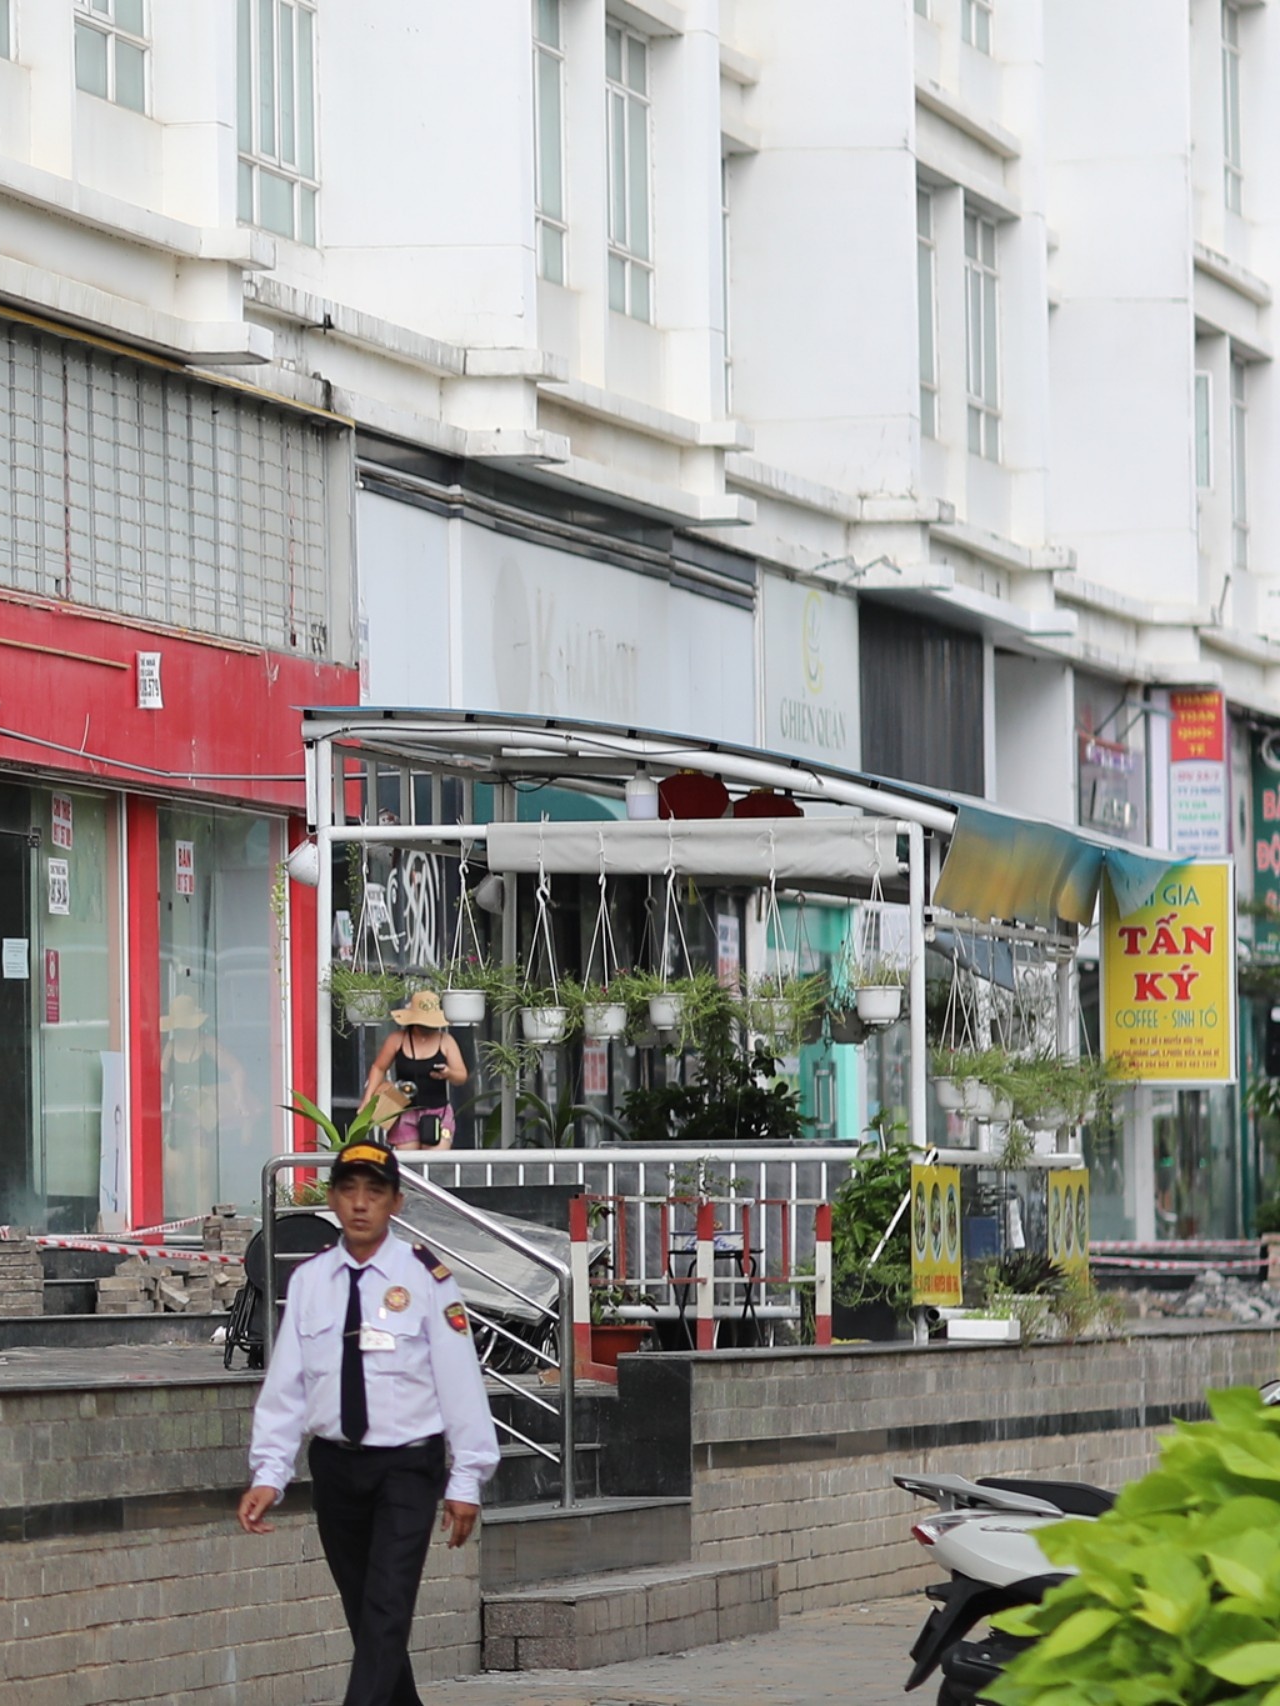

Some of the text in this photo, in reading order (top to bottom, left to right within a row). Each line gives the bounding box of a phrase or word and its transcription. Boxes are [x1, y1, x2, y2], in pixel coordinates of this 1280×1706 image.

[1118, 912, 1215, 956] TẤN
[1133, 963, 1200, 1002] KÝ
[1115, 1009, 1159, 1029] COFFEE
[1171, 1009, 1195, 1029] SINH
